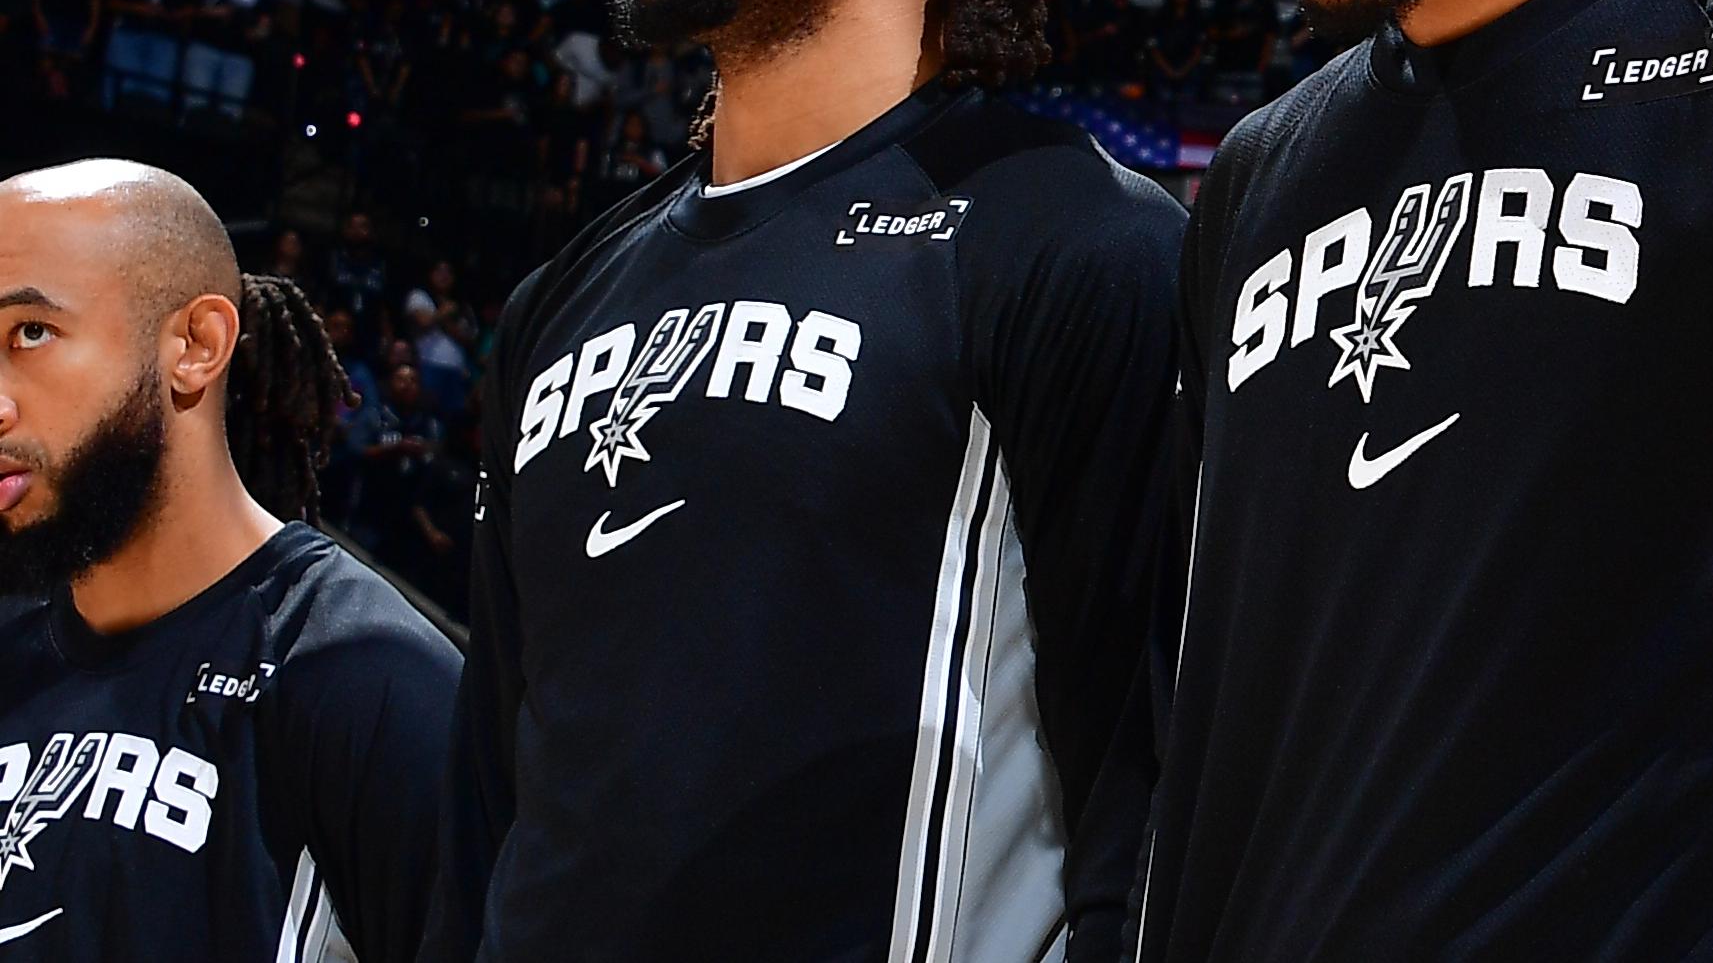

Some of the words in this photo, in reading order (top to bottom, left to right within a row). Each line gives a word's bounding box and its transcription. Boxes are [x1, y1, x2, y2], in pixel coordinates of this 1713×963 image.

[1604, 48, 1710, 85] LEDGER
[856, 211, 946, 235] LEDGER
[1227, 167, 1644, 403] SPURS
[514, 300, 862, 488] SPURS
[197, 673, 257, 698] LEDG
